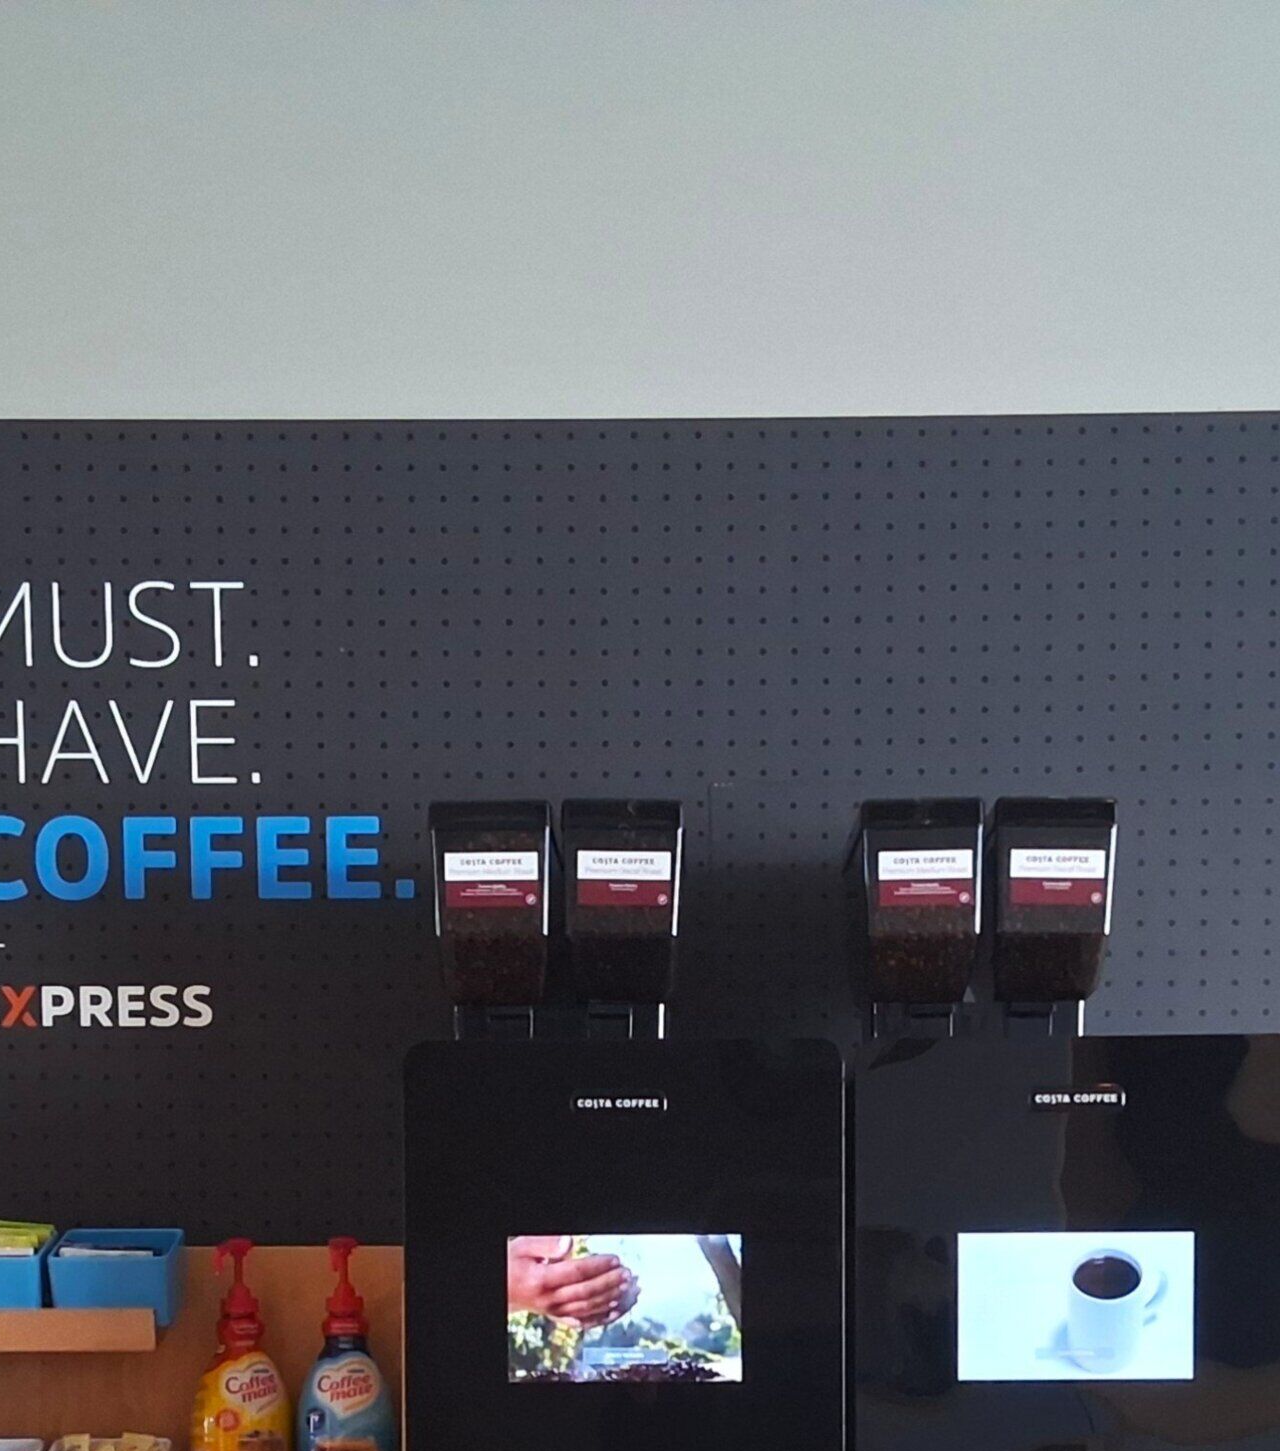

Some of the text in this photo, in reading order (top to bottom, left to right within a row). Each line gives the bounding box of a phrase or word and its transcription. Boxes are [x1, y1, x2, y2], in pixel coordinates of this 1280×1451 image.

[577, 1098, 659, 1110] COSTA COFFEE
[1034, 1093, 1118, 1105] COSTA COFFEE
[317, 1373, 371, 1393] Coffee
[330, 1382, 373, 1403] mate
